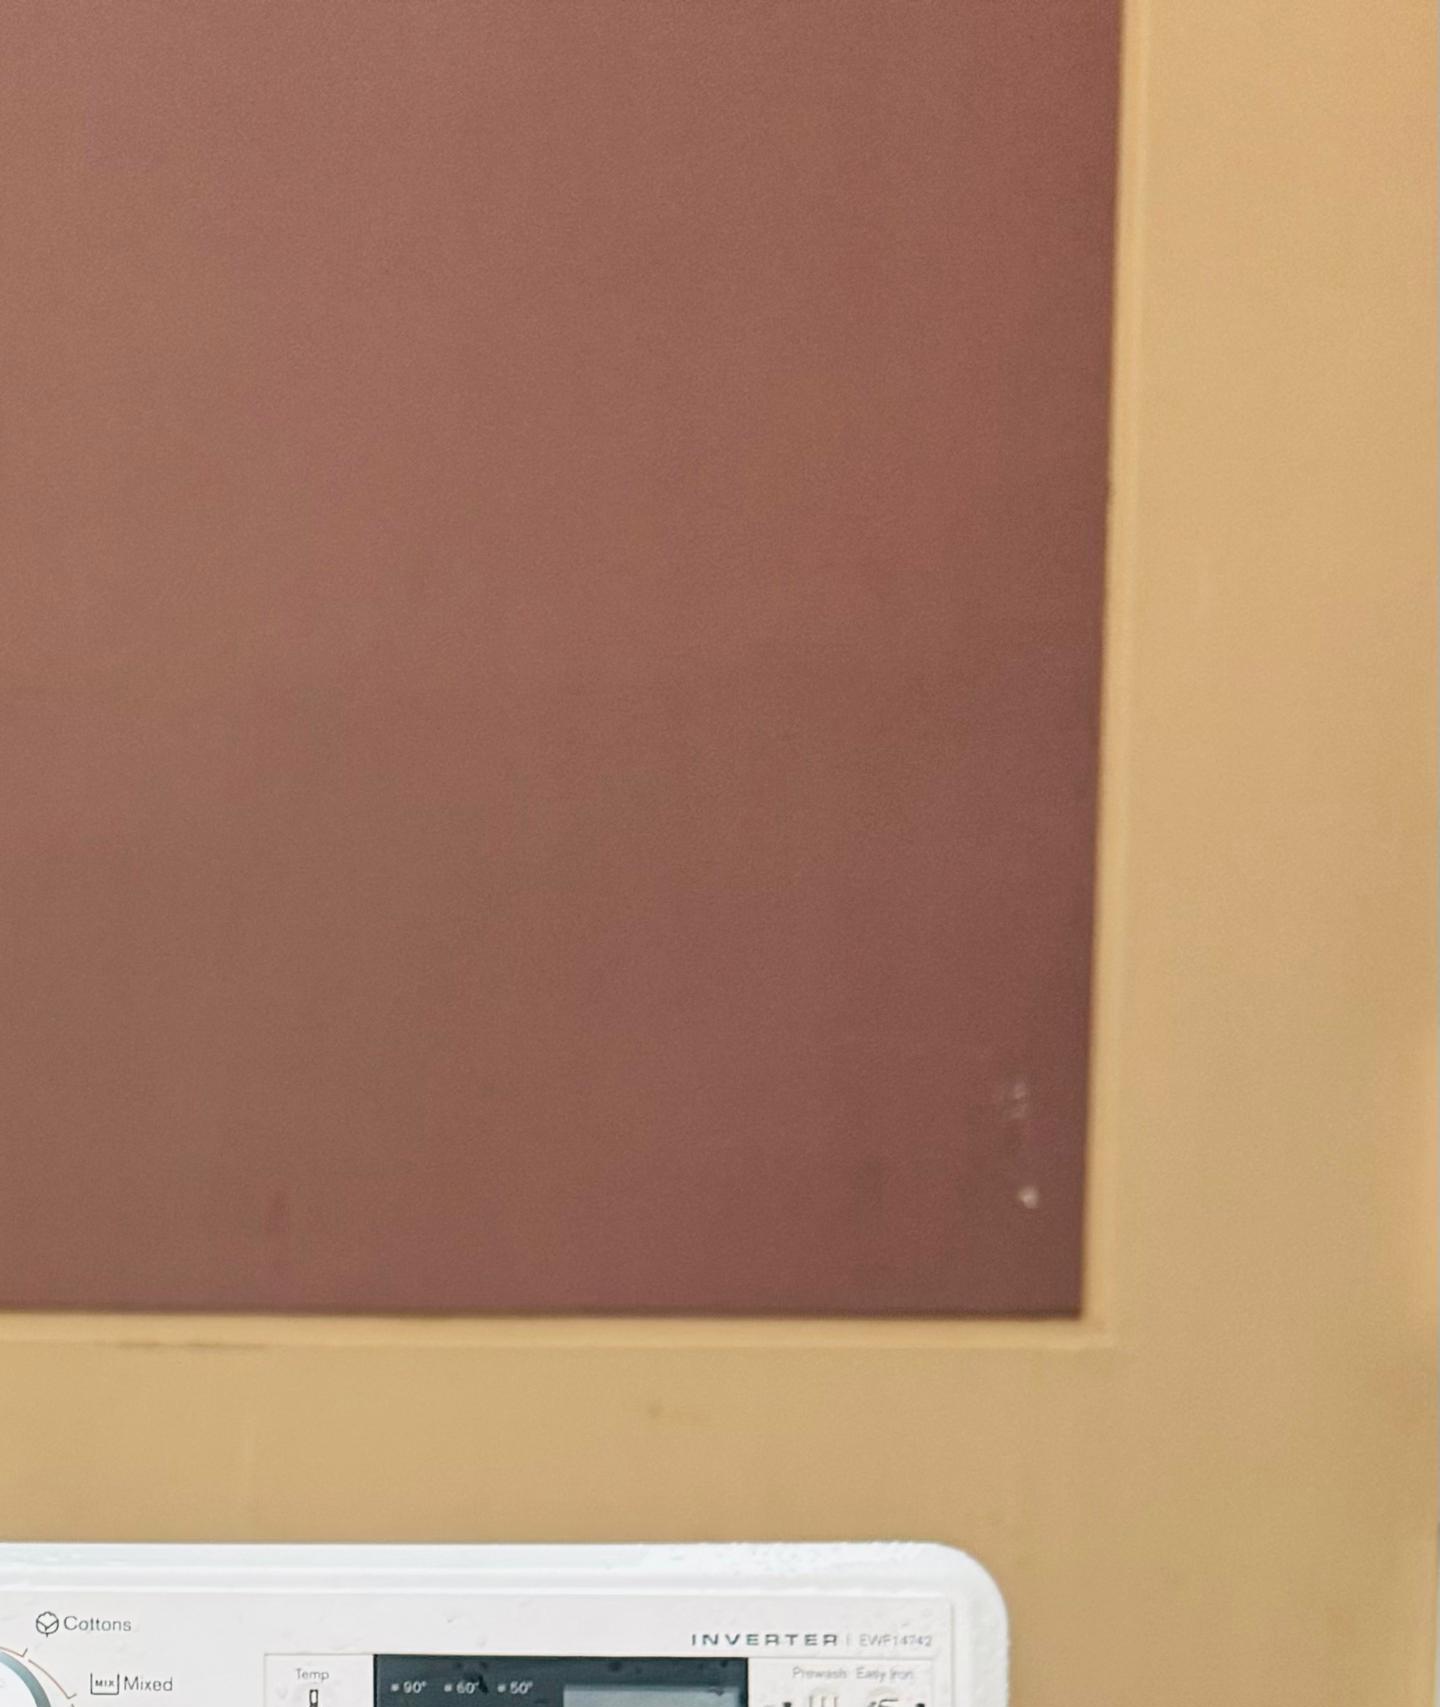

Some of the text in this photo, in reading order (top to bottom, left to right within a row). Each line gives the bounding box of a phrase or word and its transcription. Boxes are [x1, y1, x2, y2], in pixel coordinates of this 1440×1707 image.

[63, 1615, 132, 1632] Cottons
[691, 1633, 838, 1646] INVERTER
[296, 1668, 330, 1681] Temp
[792, 1666, 847, 1679] Prewash
[123, 1676, 174, 1692] Mixed
